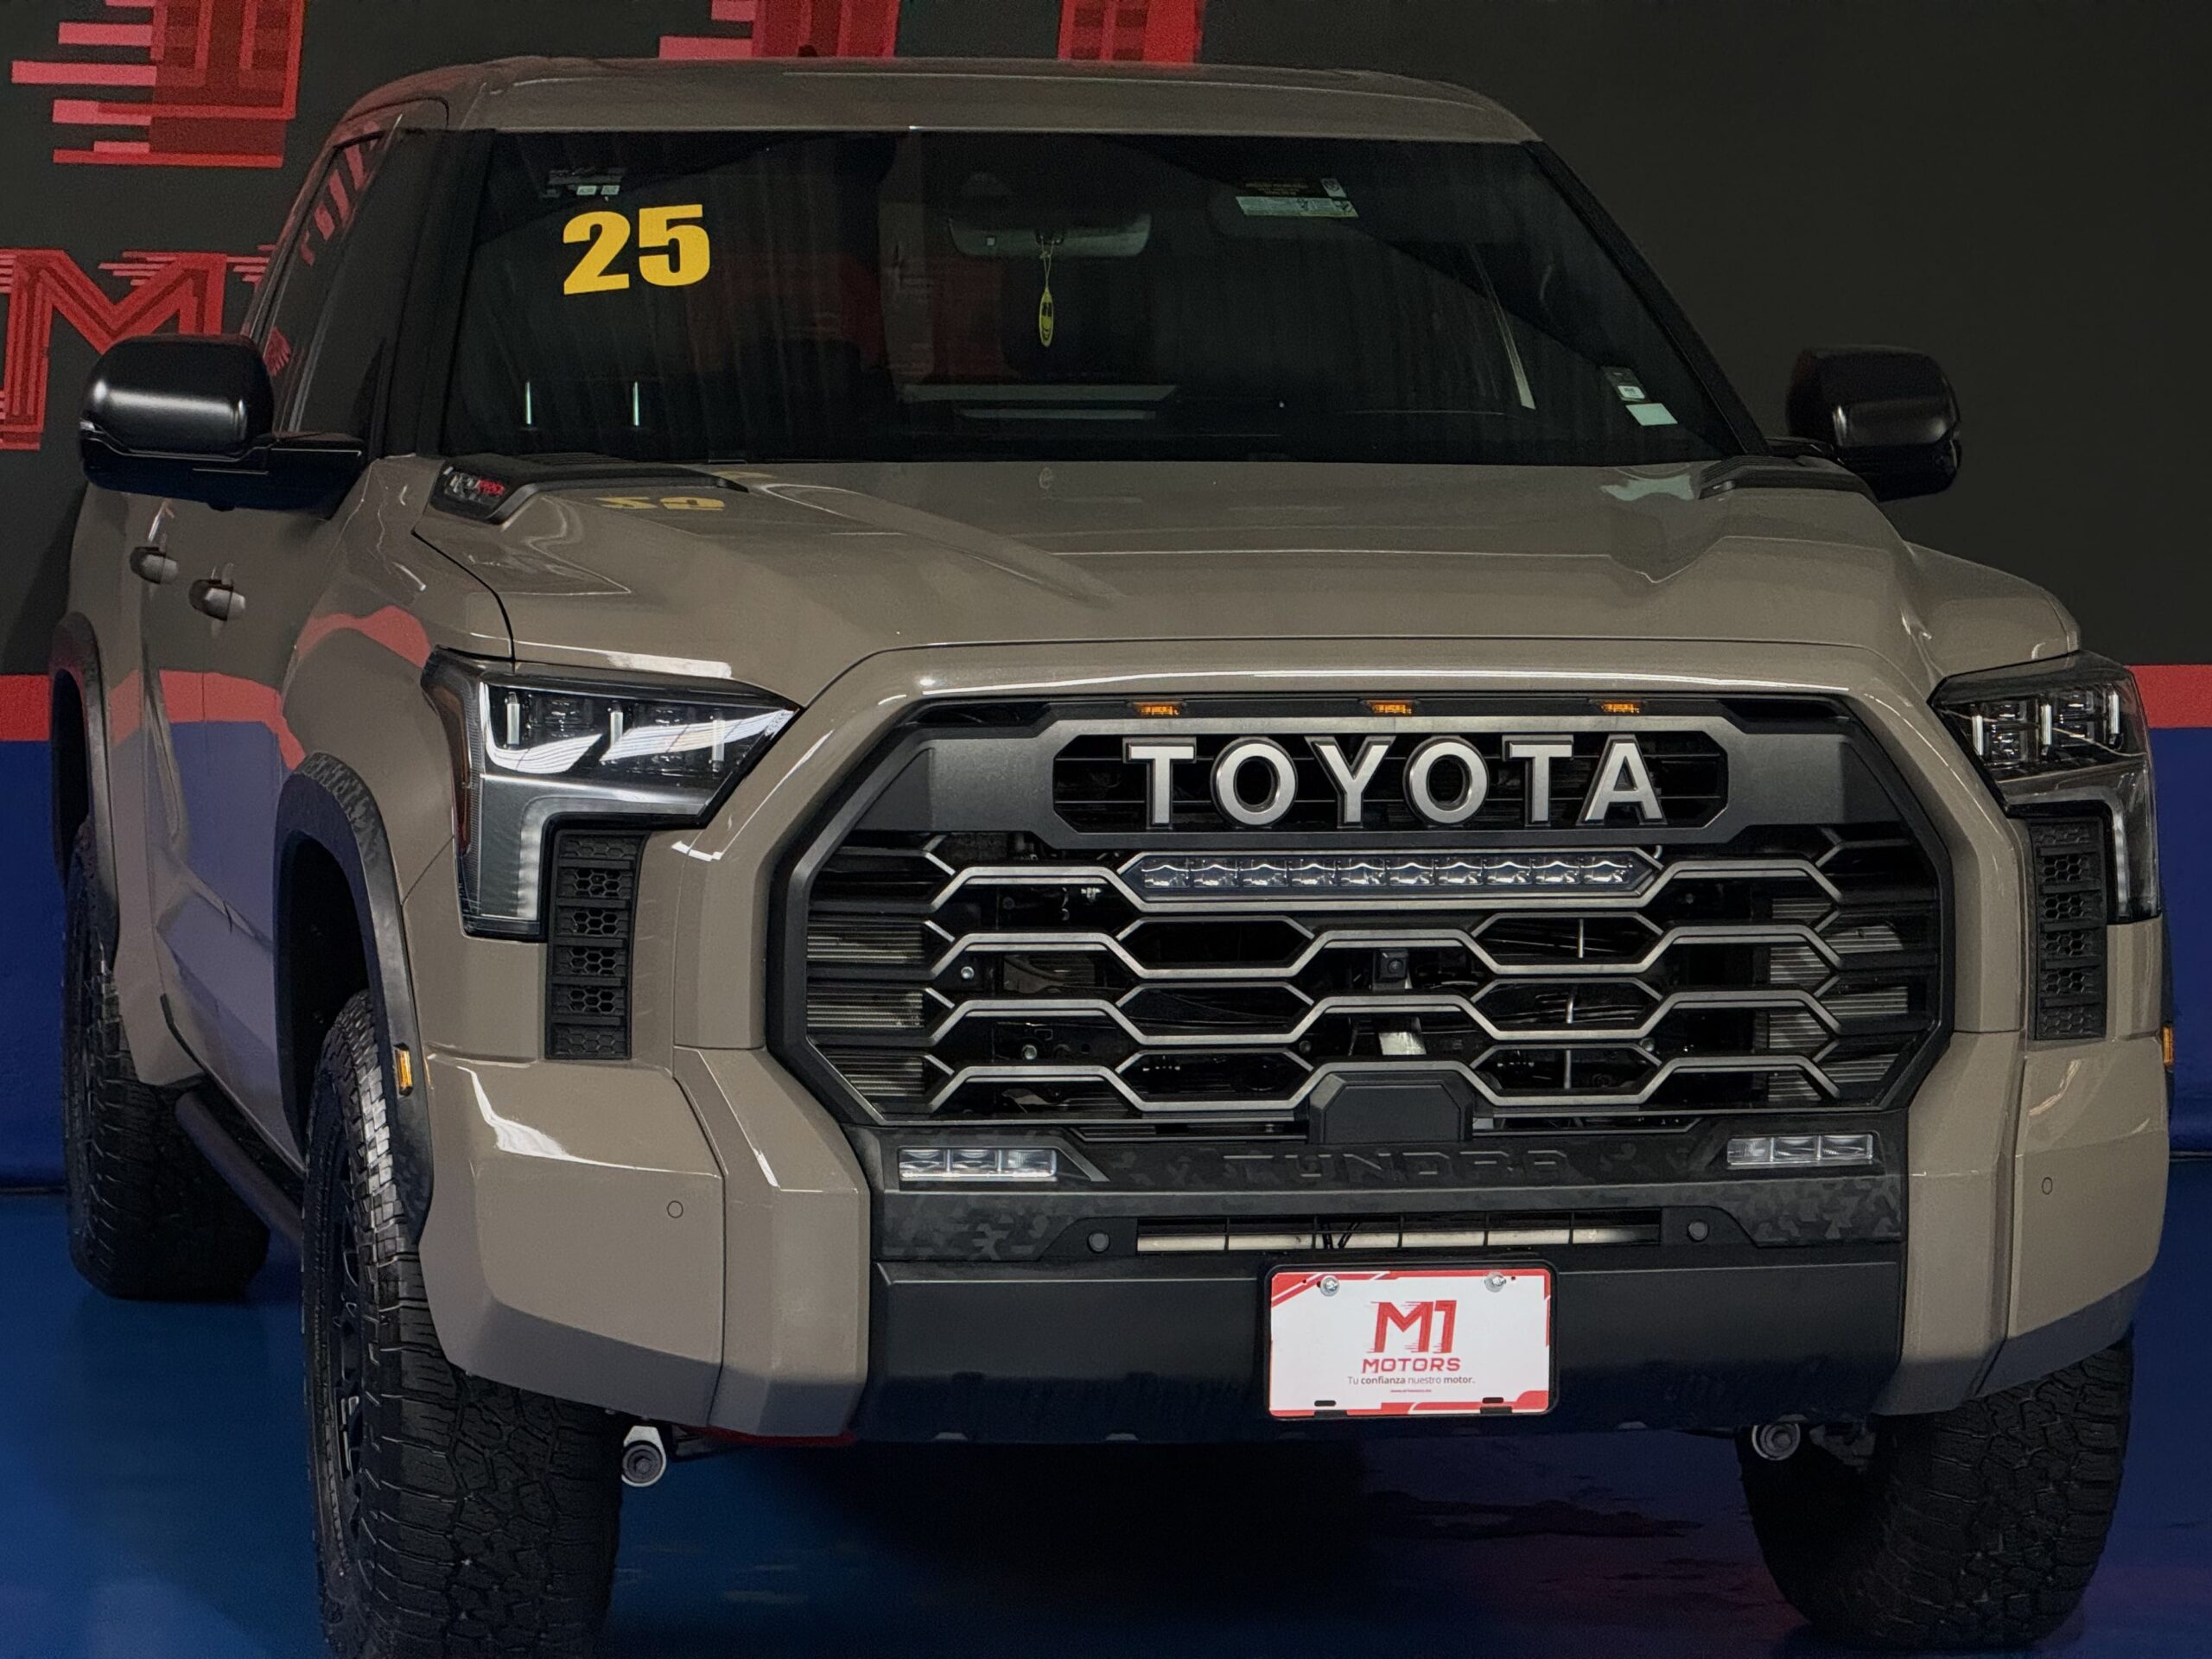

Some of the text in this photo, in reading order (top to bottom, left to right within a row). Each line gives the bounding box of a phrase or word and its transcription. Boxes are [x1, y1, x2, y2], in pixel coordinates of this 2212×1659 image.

[563, 204, 710, 295] 25
[1123, 735, 1667, 830] TOYOTA
[1223, 1151, 1571, 1183] TUNDRA
[1366, 1300, 1457, 1354] M1
[1348, 1376, 1359, 1385] Tu
[1361, 1376, 1406, 1385] confianza
[1408, 1376, 1442, 1384] nuestro
[1362, 1357, 1461, 1373] MOTORS
